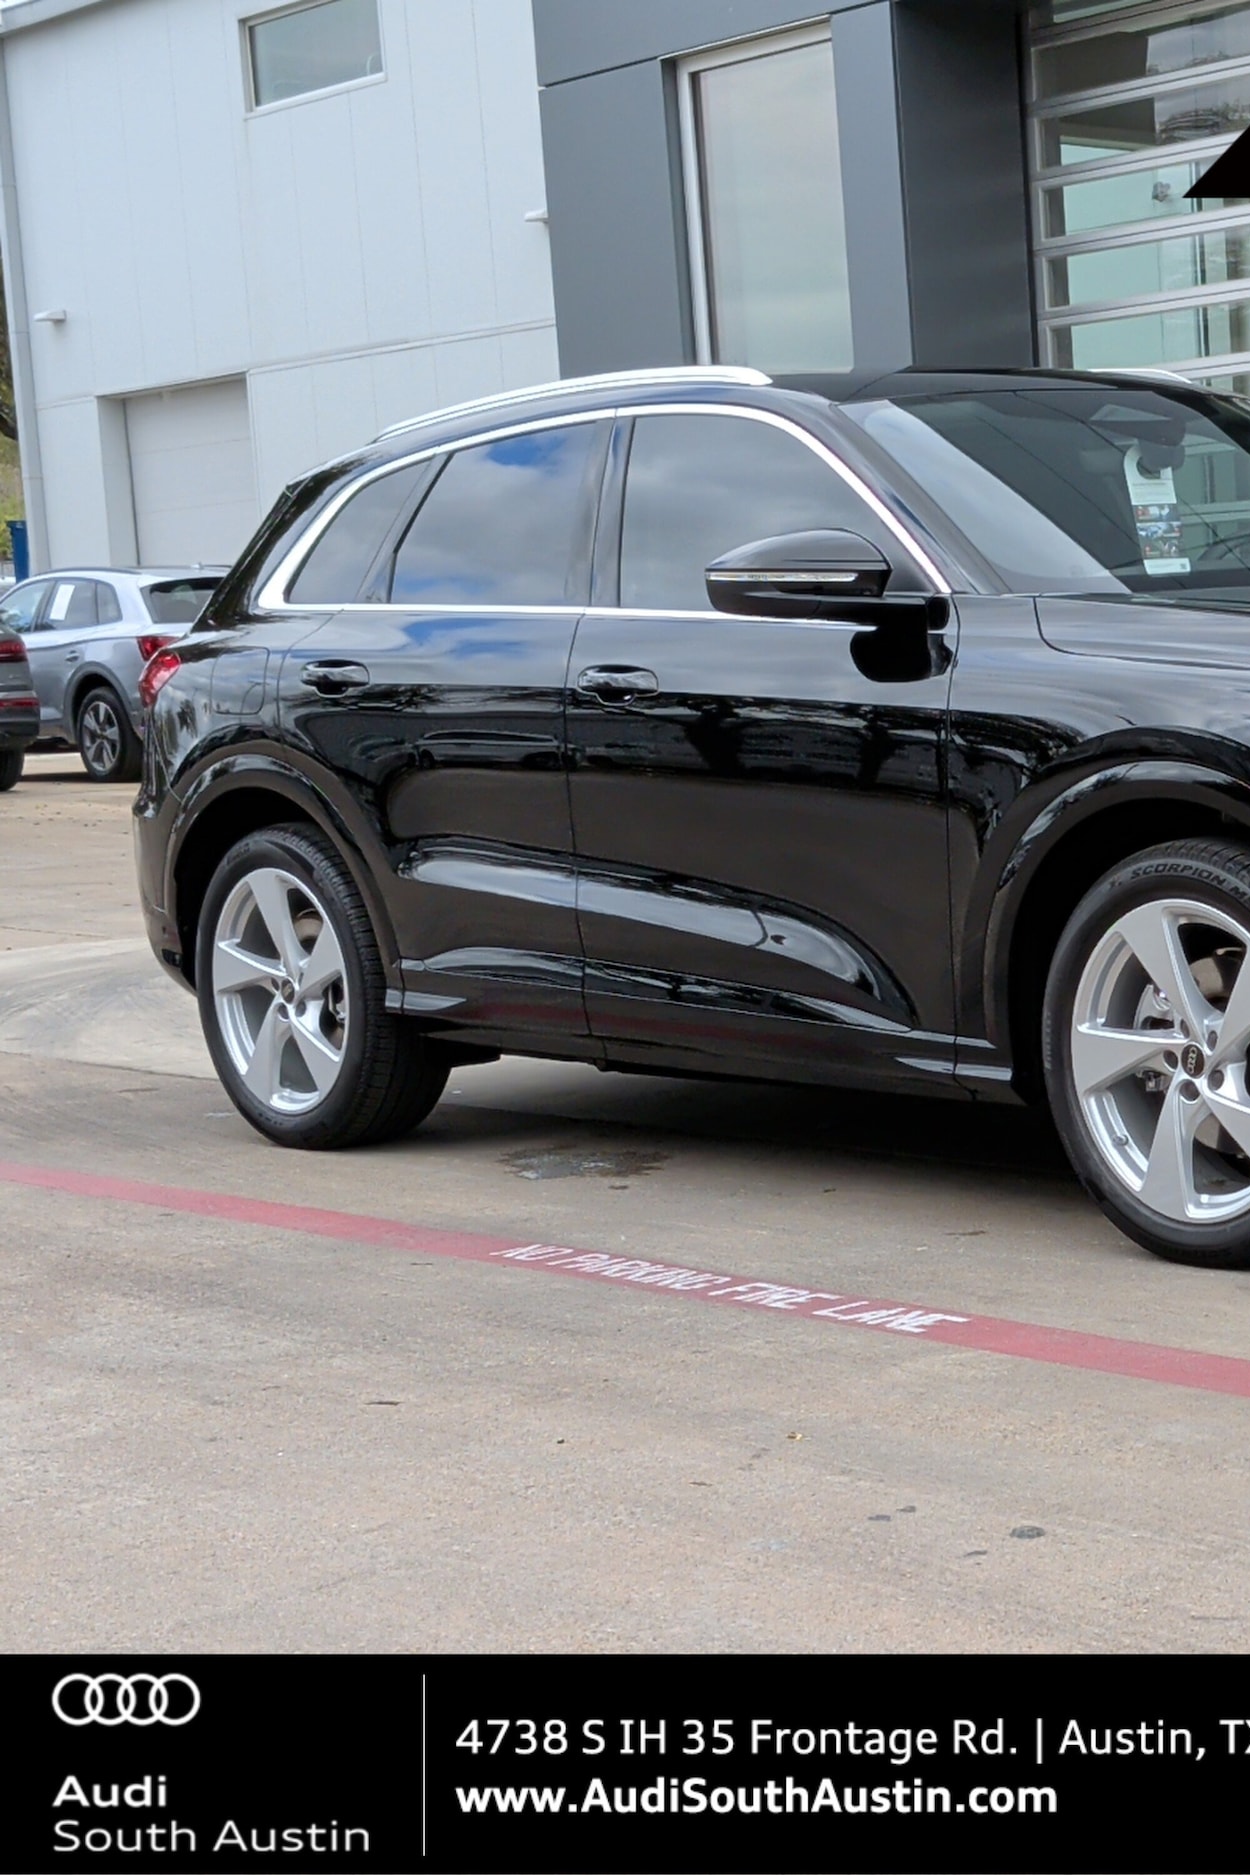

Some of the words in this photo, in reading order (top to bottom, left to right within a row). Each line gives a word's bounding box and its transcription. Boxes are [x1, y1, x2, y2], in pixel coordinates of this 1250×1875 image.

[1130, 863, 1227, 887] SCORPION
[489, 1243, 575, 1262] NO
[546, 1253, 732, 1291] PARKING
[708, 1282, 845, 1310] FIRE
[812, 1301, 972, 1334] LANE
